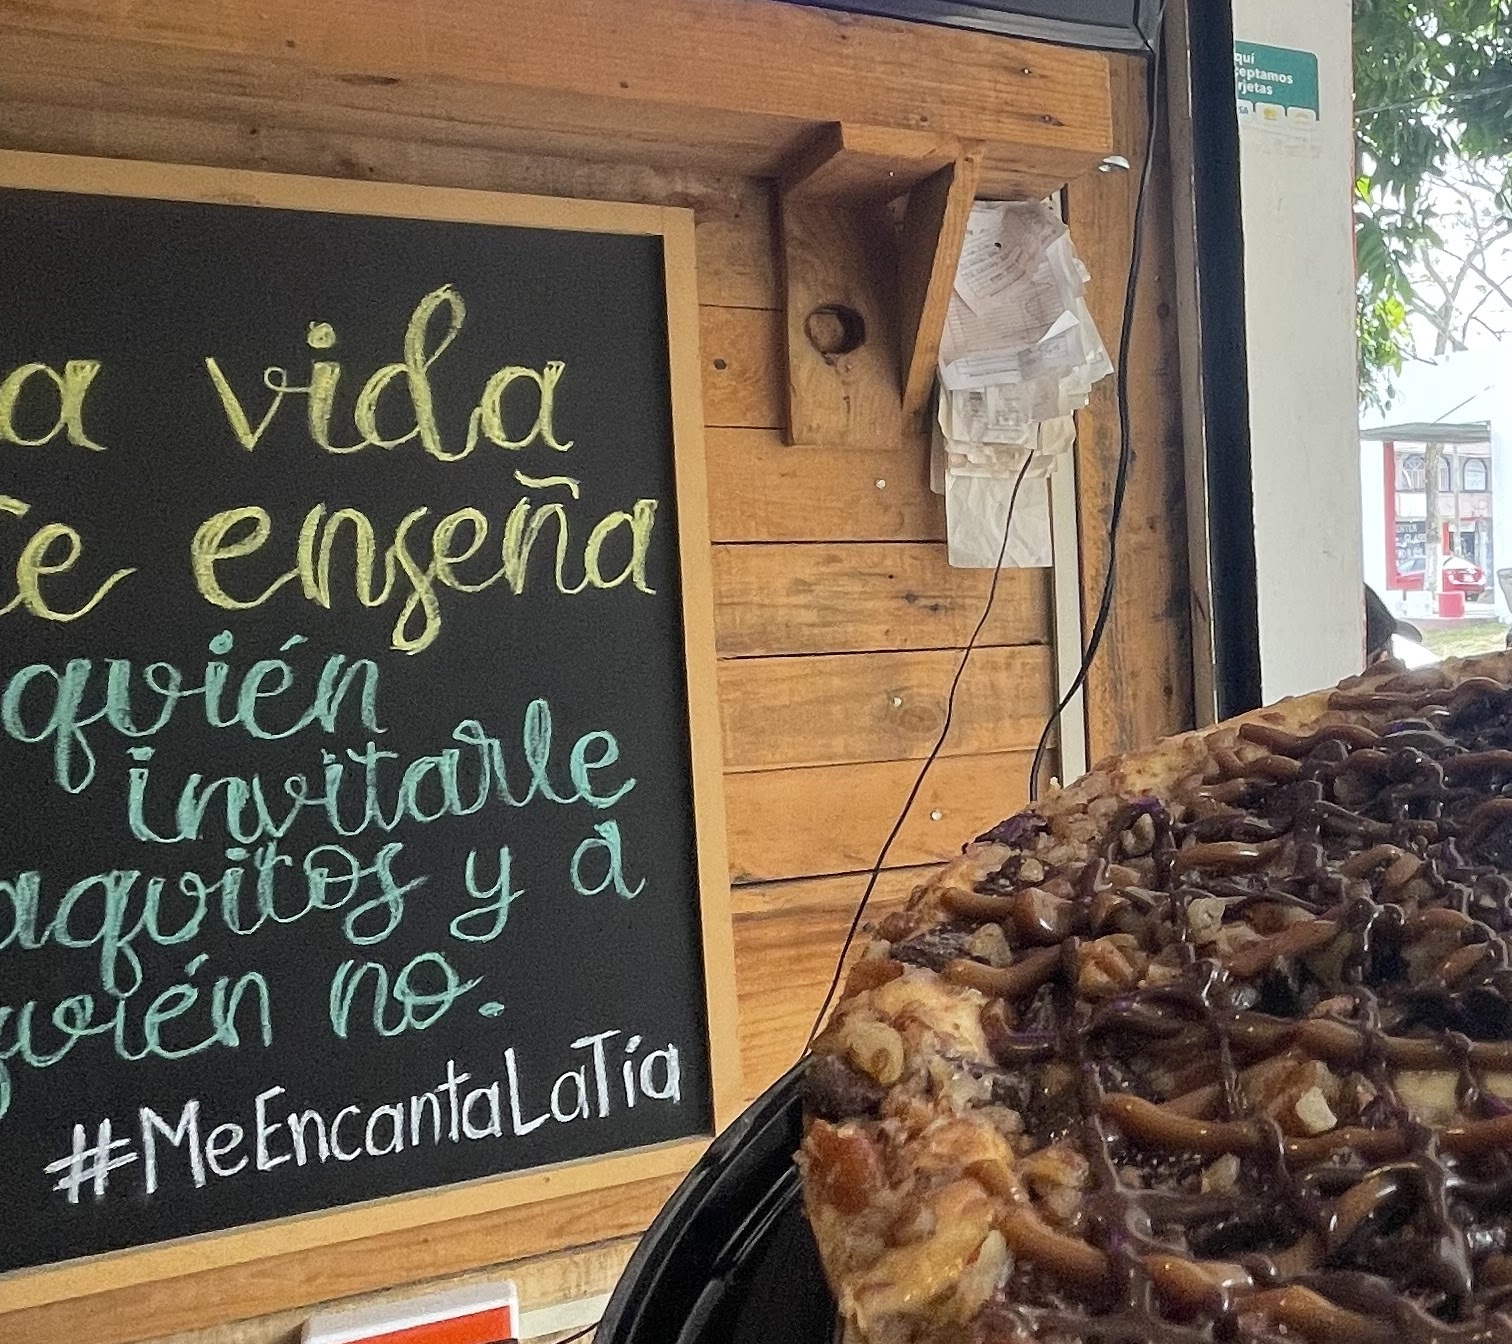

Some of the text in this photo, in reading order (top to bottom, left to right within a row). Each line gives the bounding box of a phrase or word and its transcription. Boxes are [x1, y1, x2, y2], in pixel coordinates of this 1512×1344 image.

[205, 283, 574, 462] vida
[0, 469, 659, 656] e enseña
[2, 630, 388, 794] quién
[126, 697, 638, 844] invitarle
[450, 845, 525, 943] y
[0, 952, 505, 1119] uién no.
[44, 1029, 683, 1204] #MeEncantaLaTía
